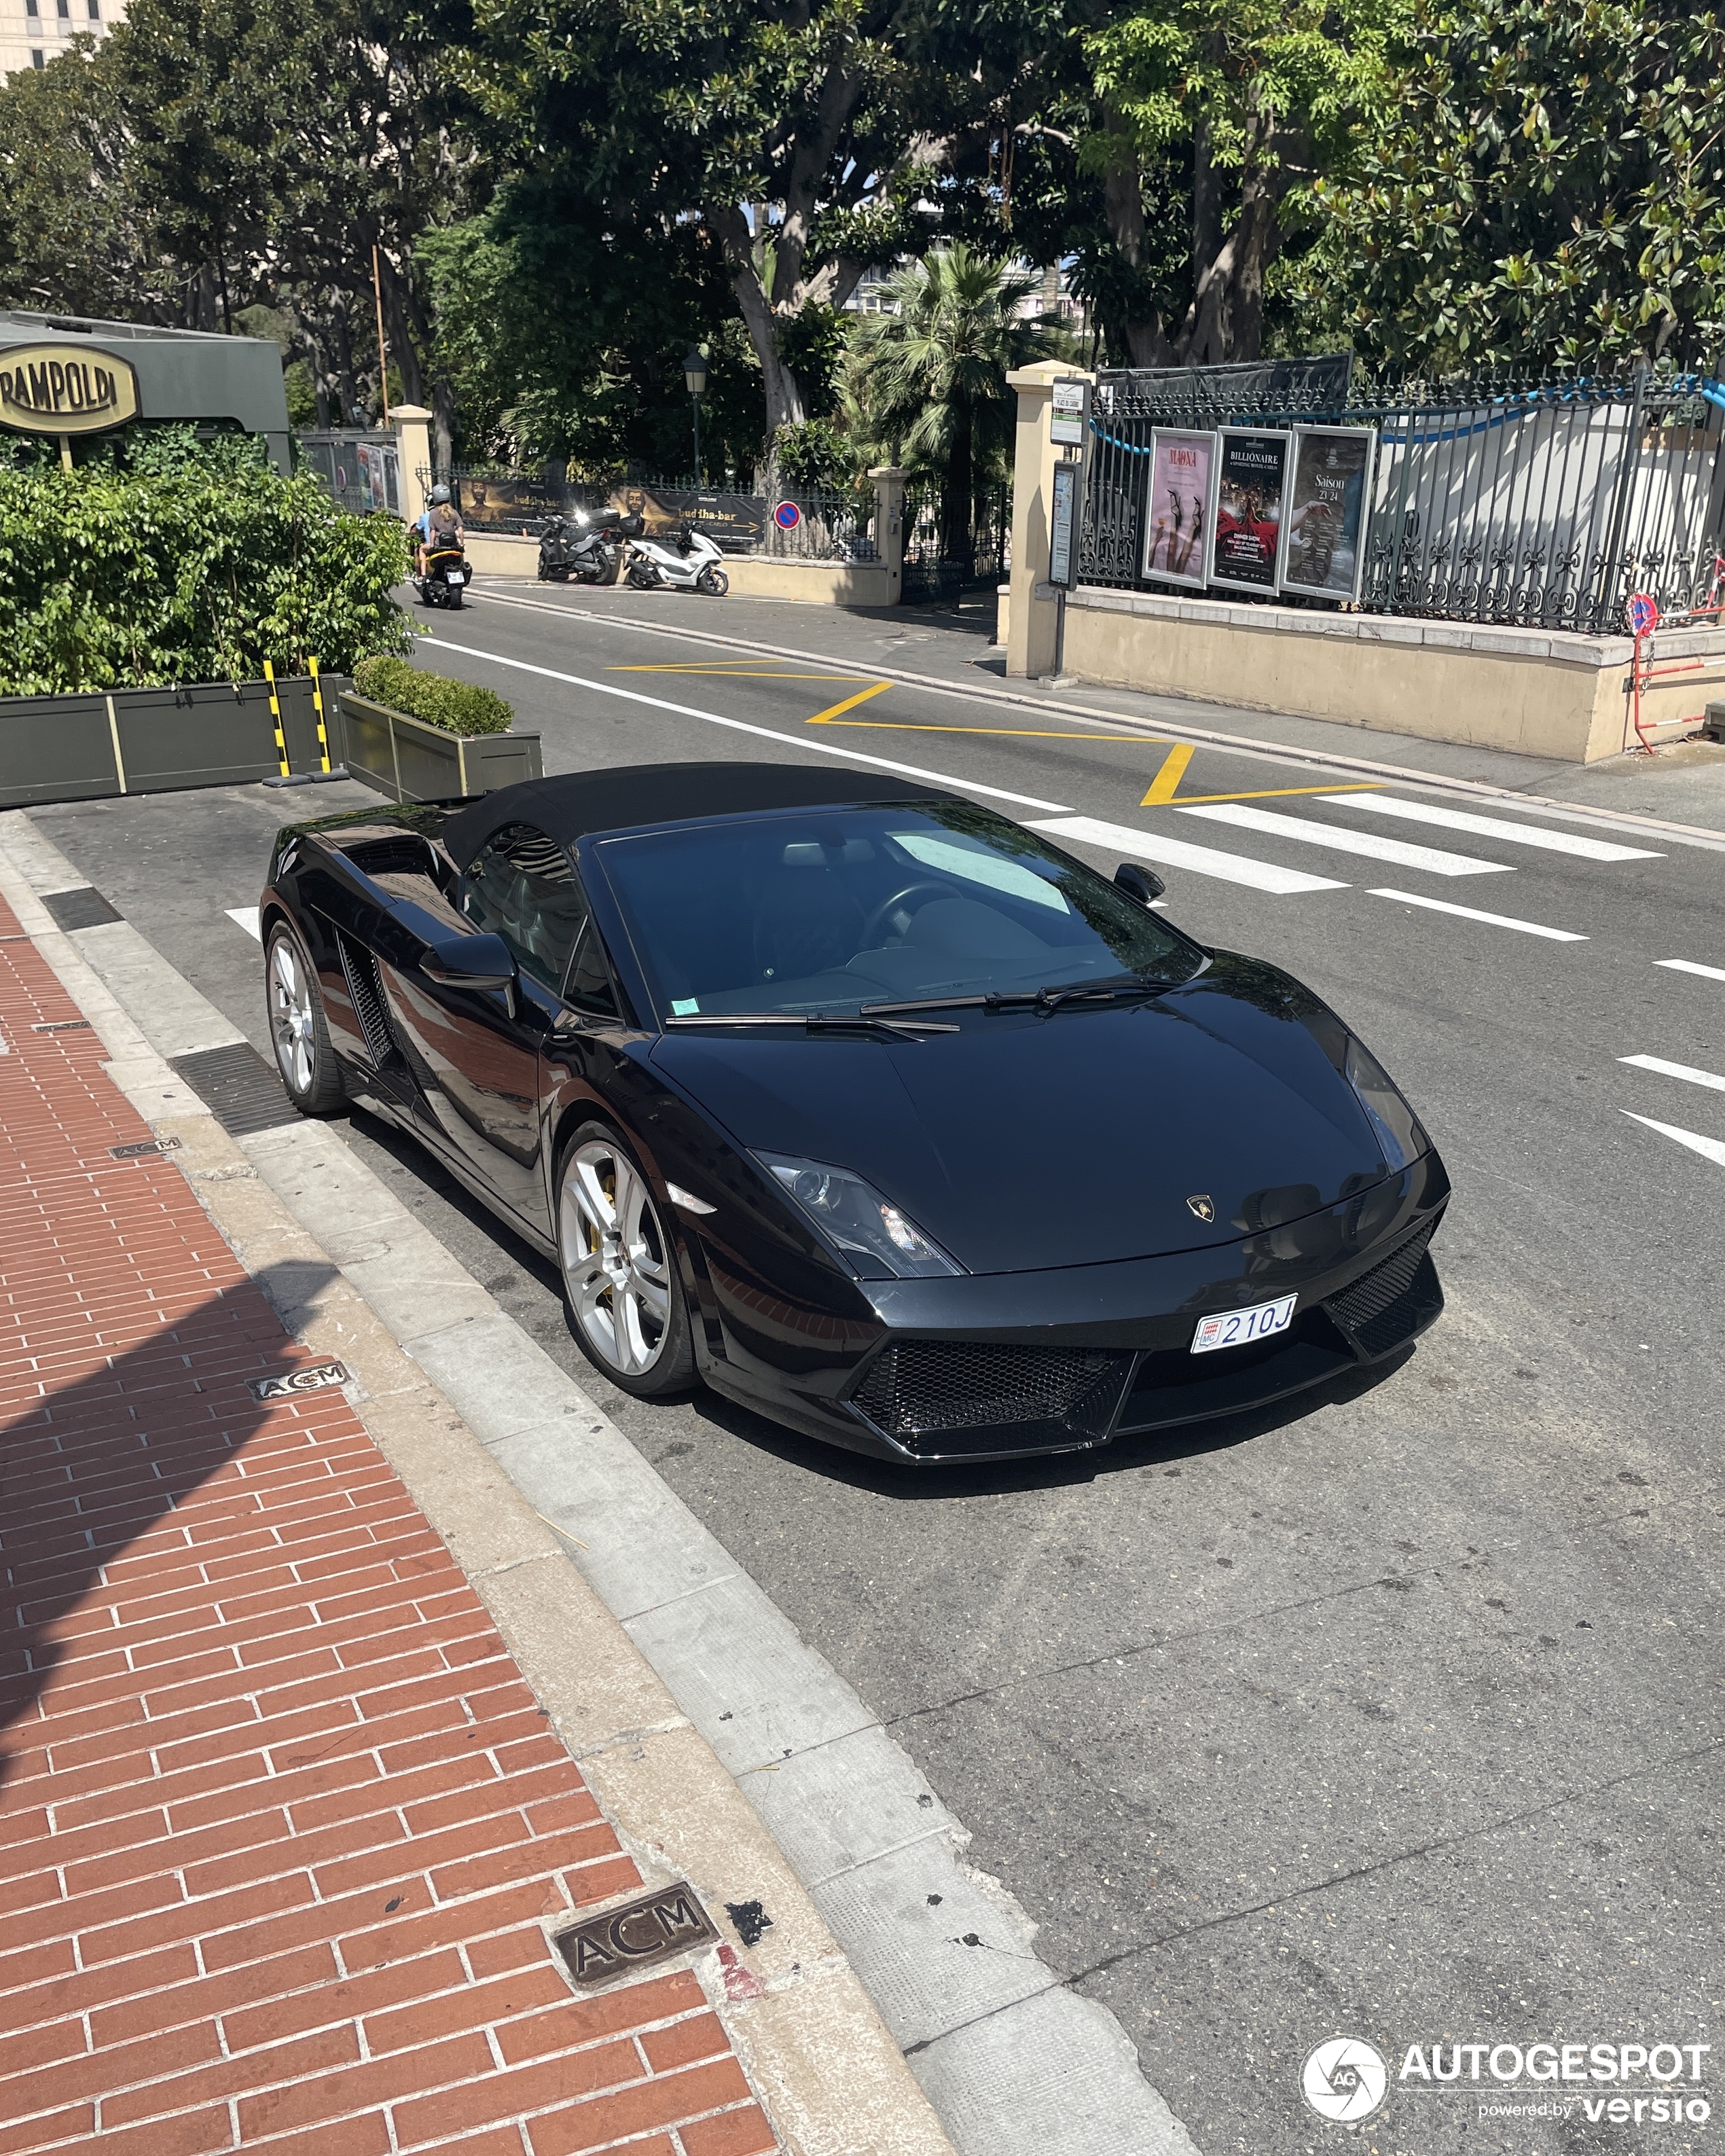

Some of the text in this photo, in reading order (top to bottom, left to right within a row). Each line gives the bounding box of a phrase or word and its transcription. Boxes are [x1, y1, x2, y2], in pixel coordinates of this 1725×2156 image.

[0, 361, 117, 416] RAMPOLDI
[1231, 451, 1278, 465] BILLIONAIRE
[1315, 474, 1345, 490] Saison
[1319, 490, 1338, 501] 23 24
[118, 1139, 178, 1156] ACM
[1222, 1301, 1293, 1343] 210J
[1202, 1333, 1214, 1343] MC
[263, 1366, 344, 1397] ACM
[576, 1897, 702, 1974] ACM
